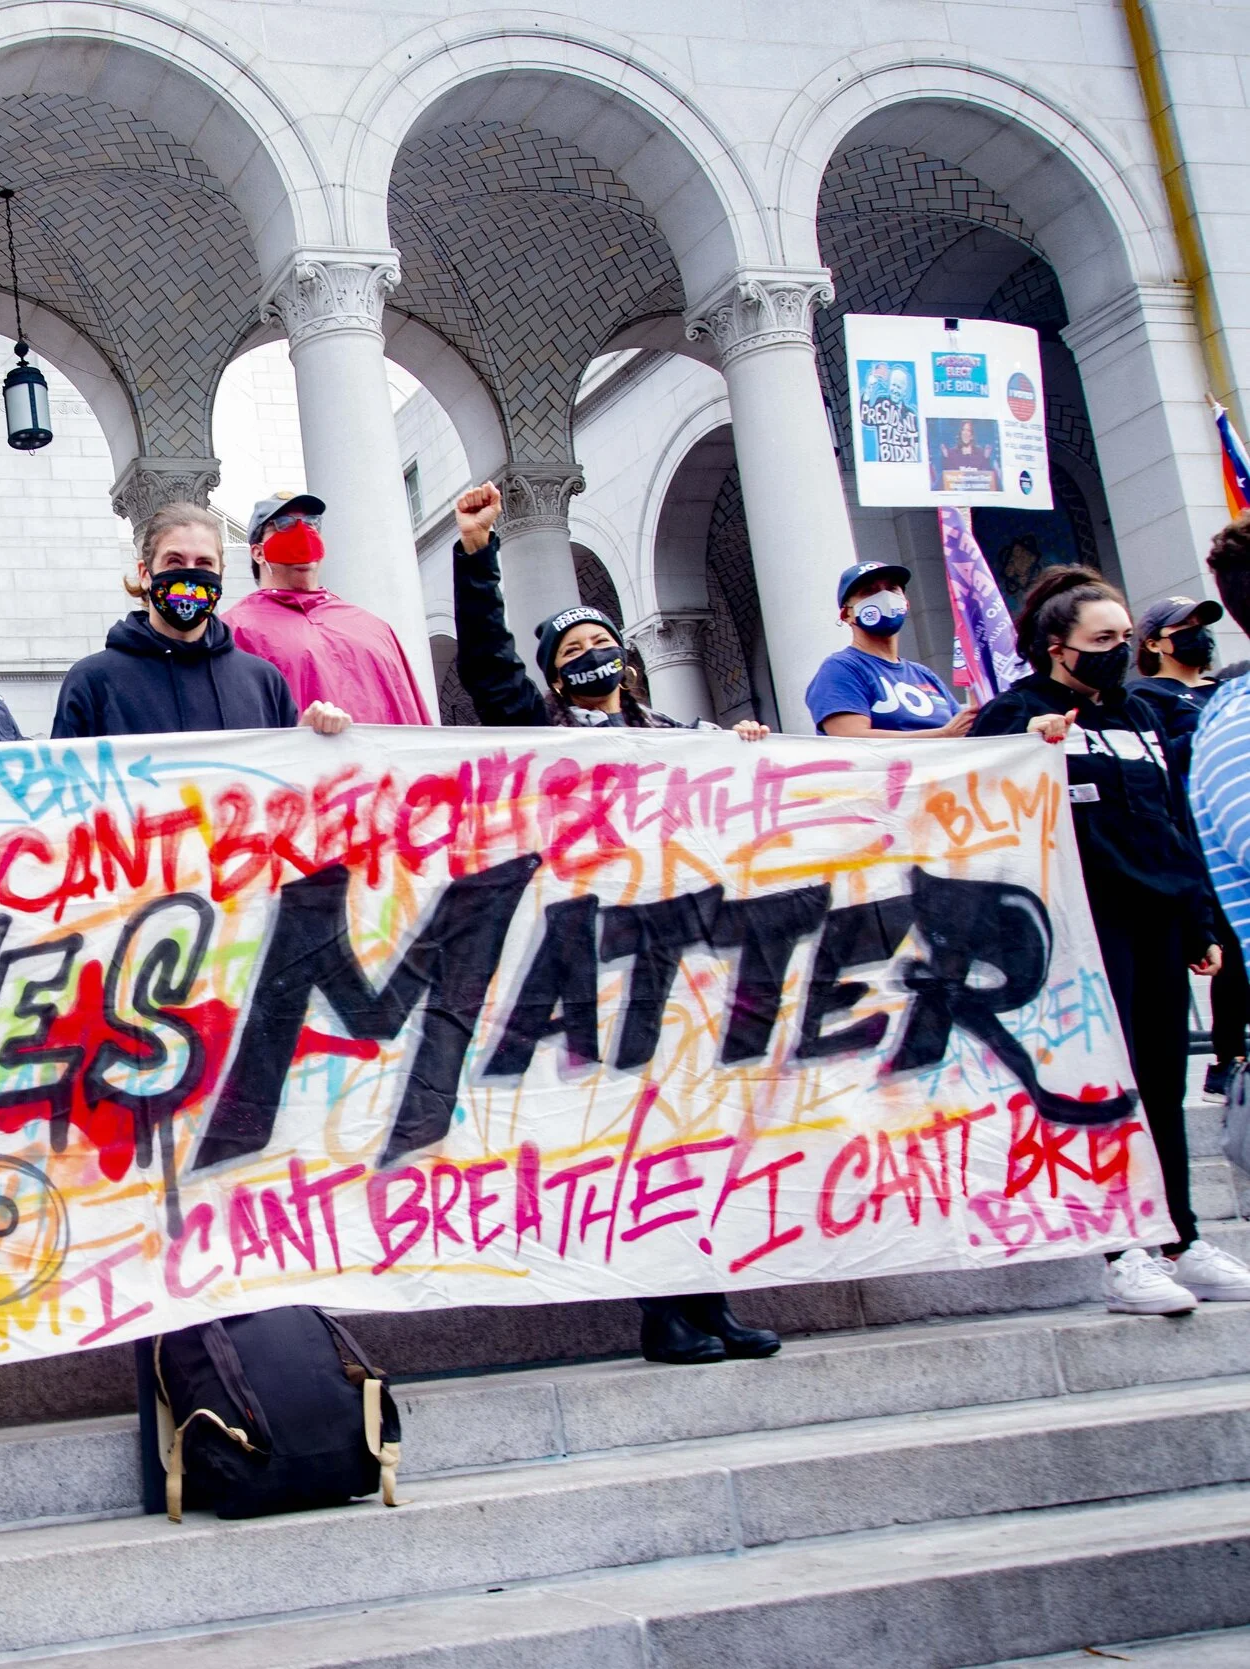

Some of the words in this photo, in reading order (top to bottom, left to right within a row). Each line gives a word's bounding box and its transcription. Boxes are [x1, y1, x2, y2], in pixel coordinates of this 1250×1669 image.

[861, 400, 917, 434] PRESIDENT
[879, 424, 919, 446] ELECT
[880, 443, 919, 463] BIDEN
[568, 658, 624, 686] JUSTICE
[190, 852, 1140, 1170] MATTER
